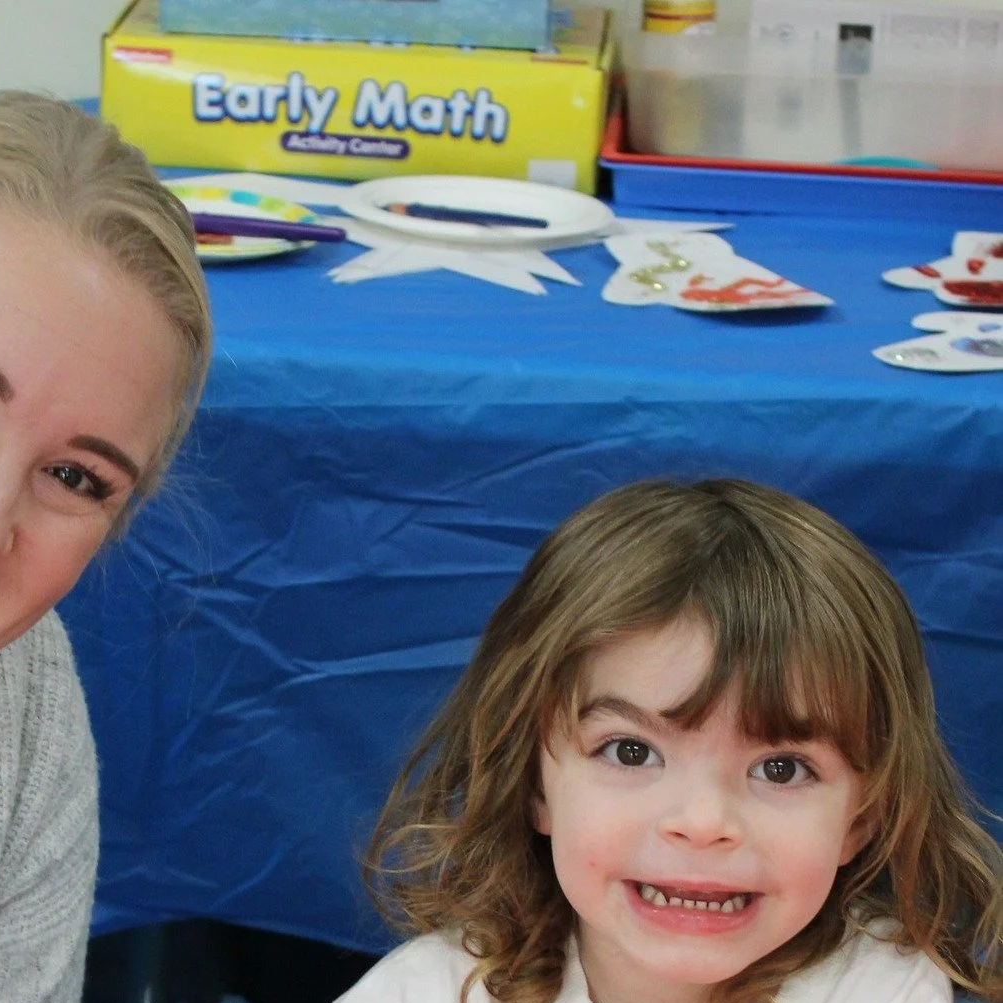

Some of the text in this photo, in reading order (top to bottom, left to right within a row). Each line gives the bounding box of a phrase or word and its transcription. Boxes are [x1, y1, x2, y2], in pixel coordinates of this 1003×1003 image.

[193, 70, 508, 143] Early Math
[286, 133, 403, 156] Activity Center
